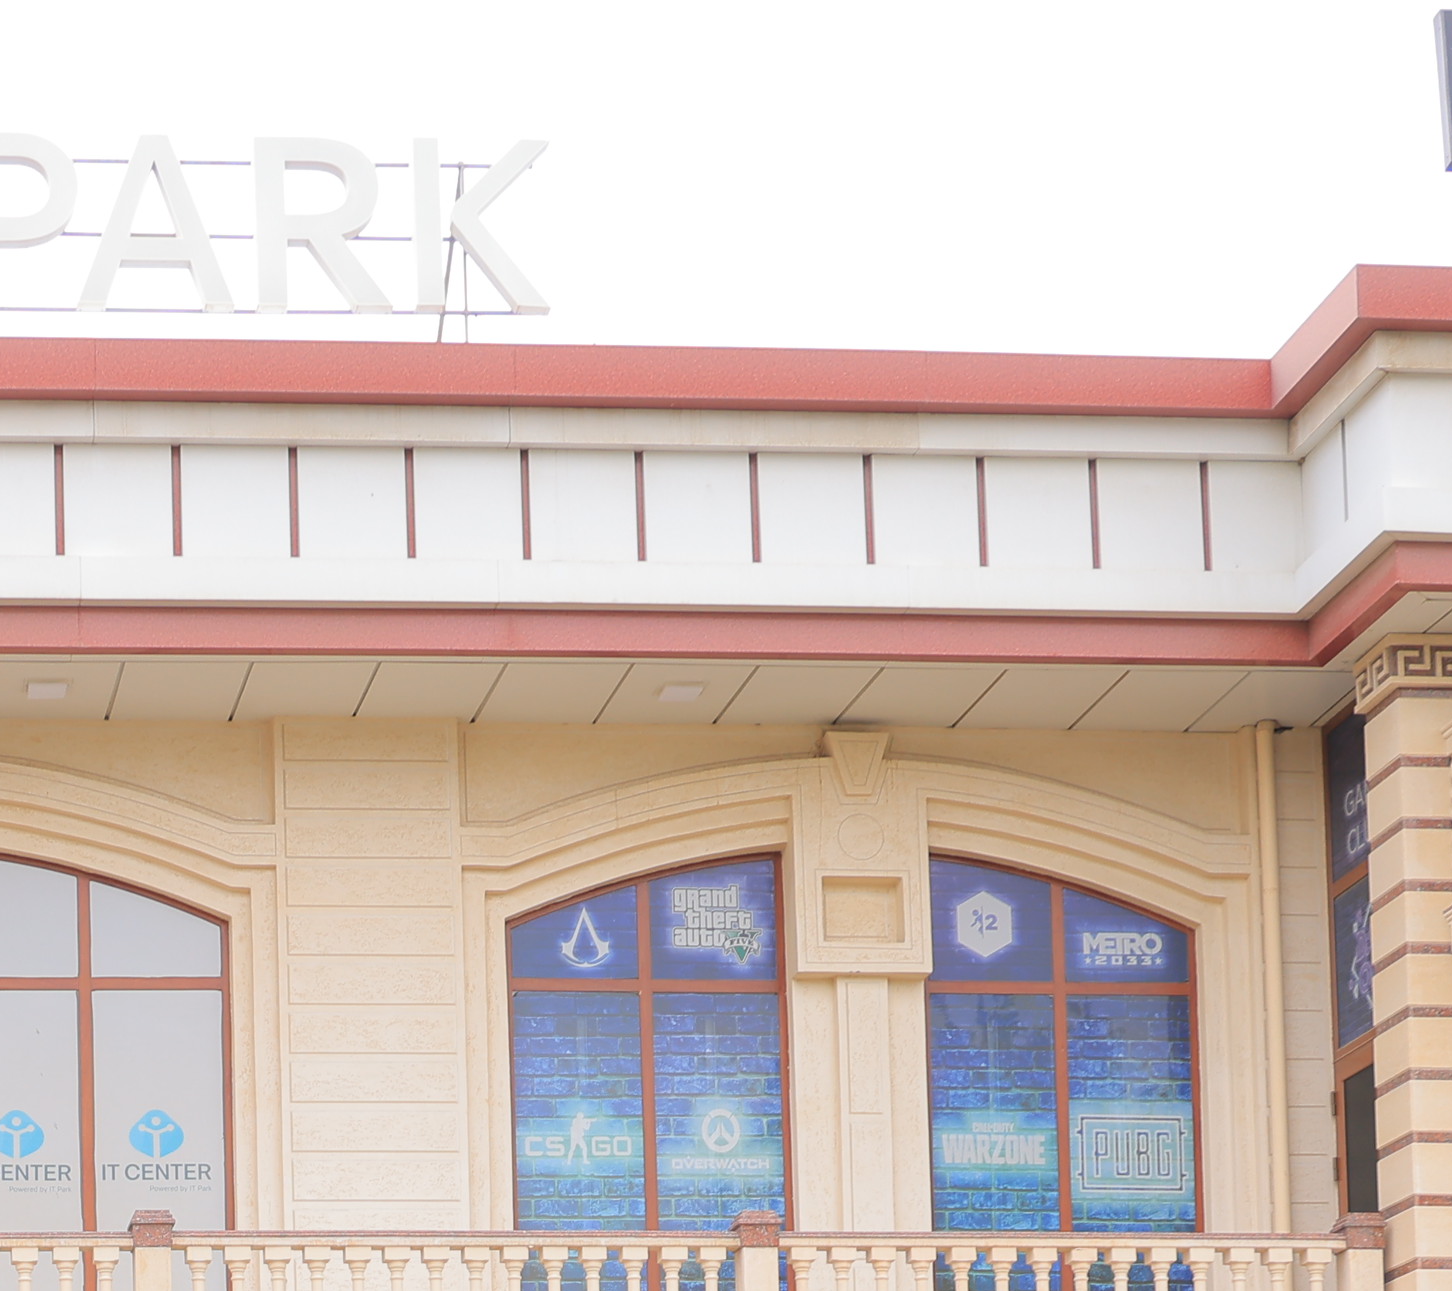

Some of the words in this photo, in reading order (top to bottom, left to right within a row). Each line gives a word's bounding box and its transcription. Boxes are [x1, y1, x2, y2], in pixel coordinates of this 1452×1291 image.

[985, 914, 998, 931] 2
[673, 928, 727, 947] auto
[1083, 932, 1163, 955] METRO
[1094, 956, 1153, 966] 2033
[524, 1136, 566, 1157] CS
[591, 1136, 632, 1157] GO
[942, 1134, 1046, 1165] WARZONE
[1093, 1129, 1172, 1179] PUBG
[102, 1164, 120, 1180] IT
[124, 1164, 211, 1180] CENTER
[672, 1158, 770, 1169] OVERWATCH
